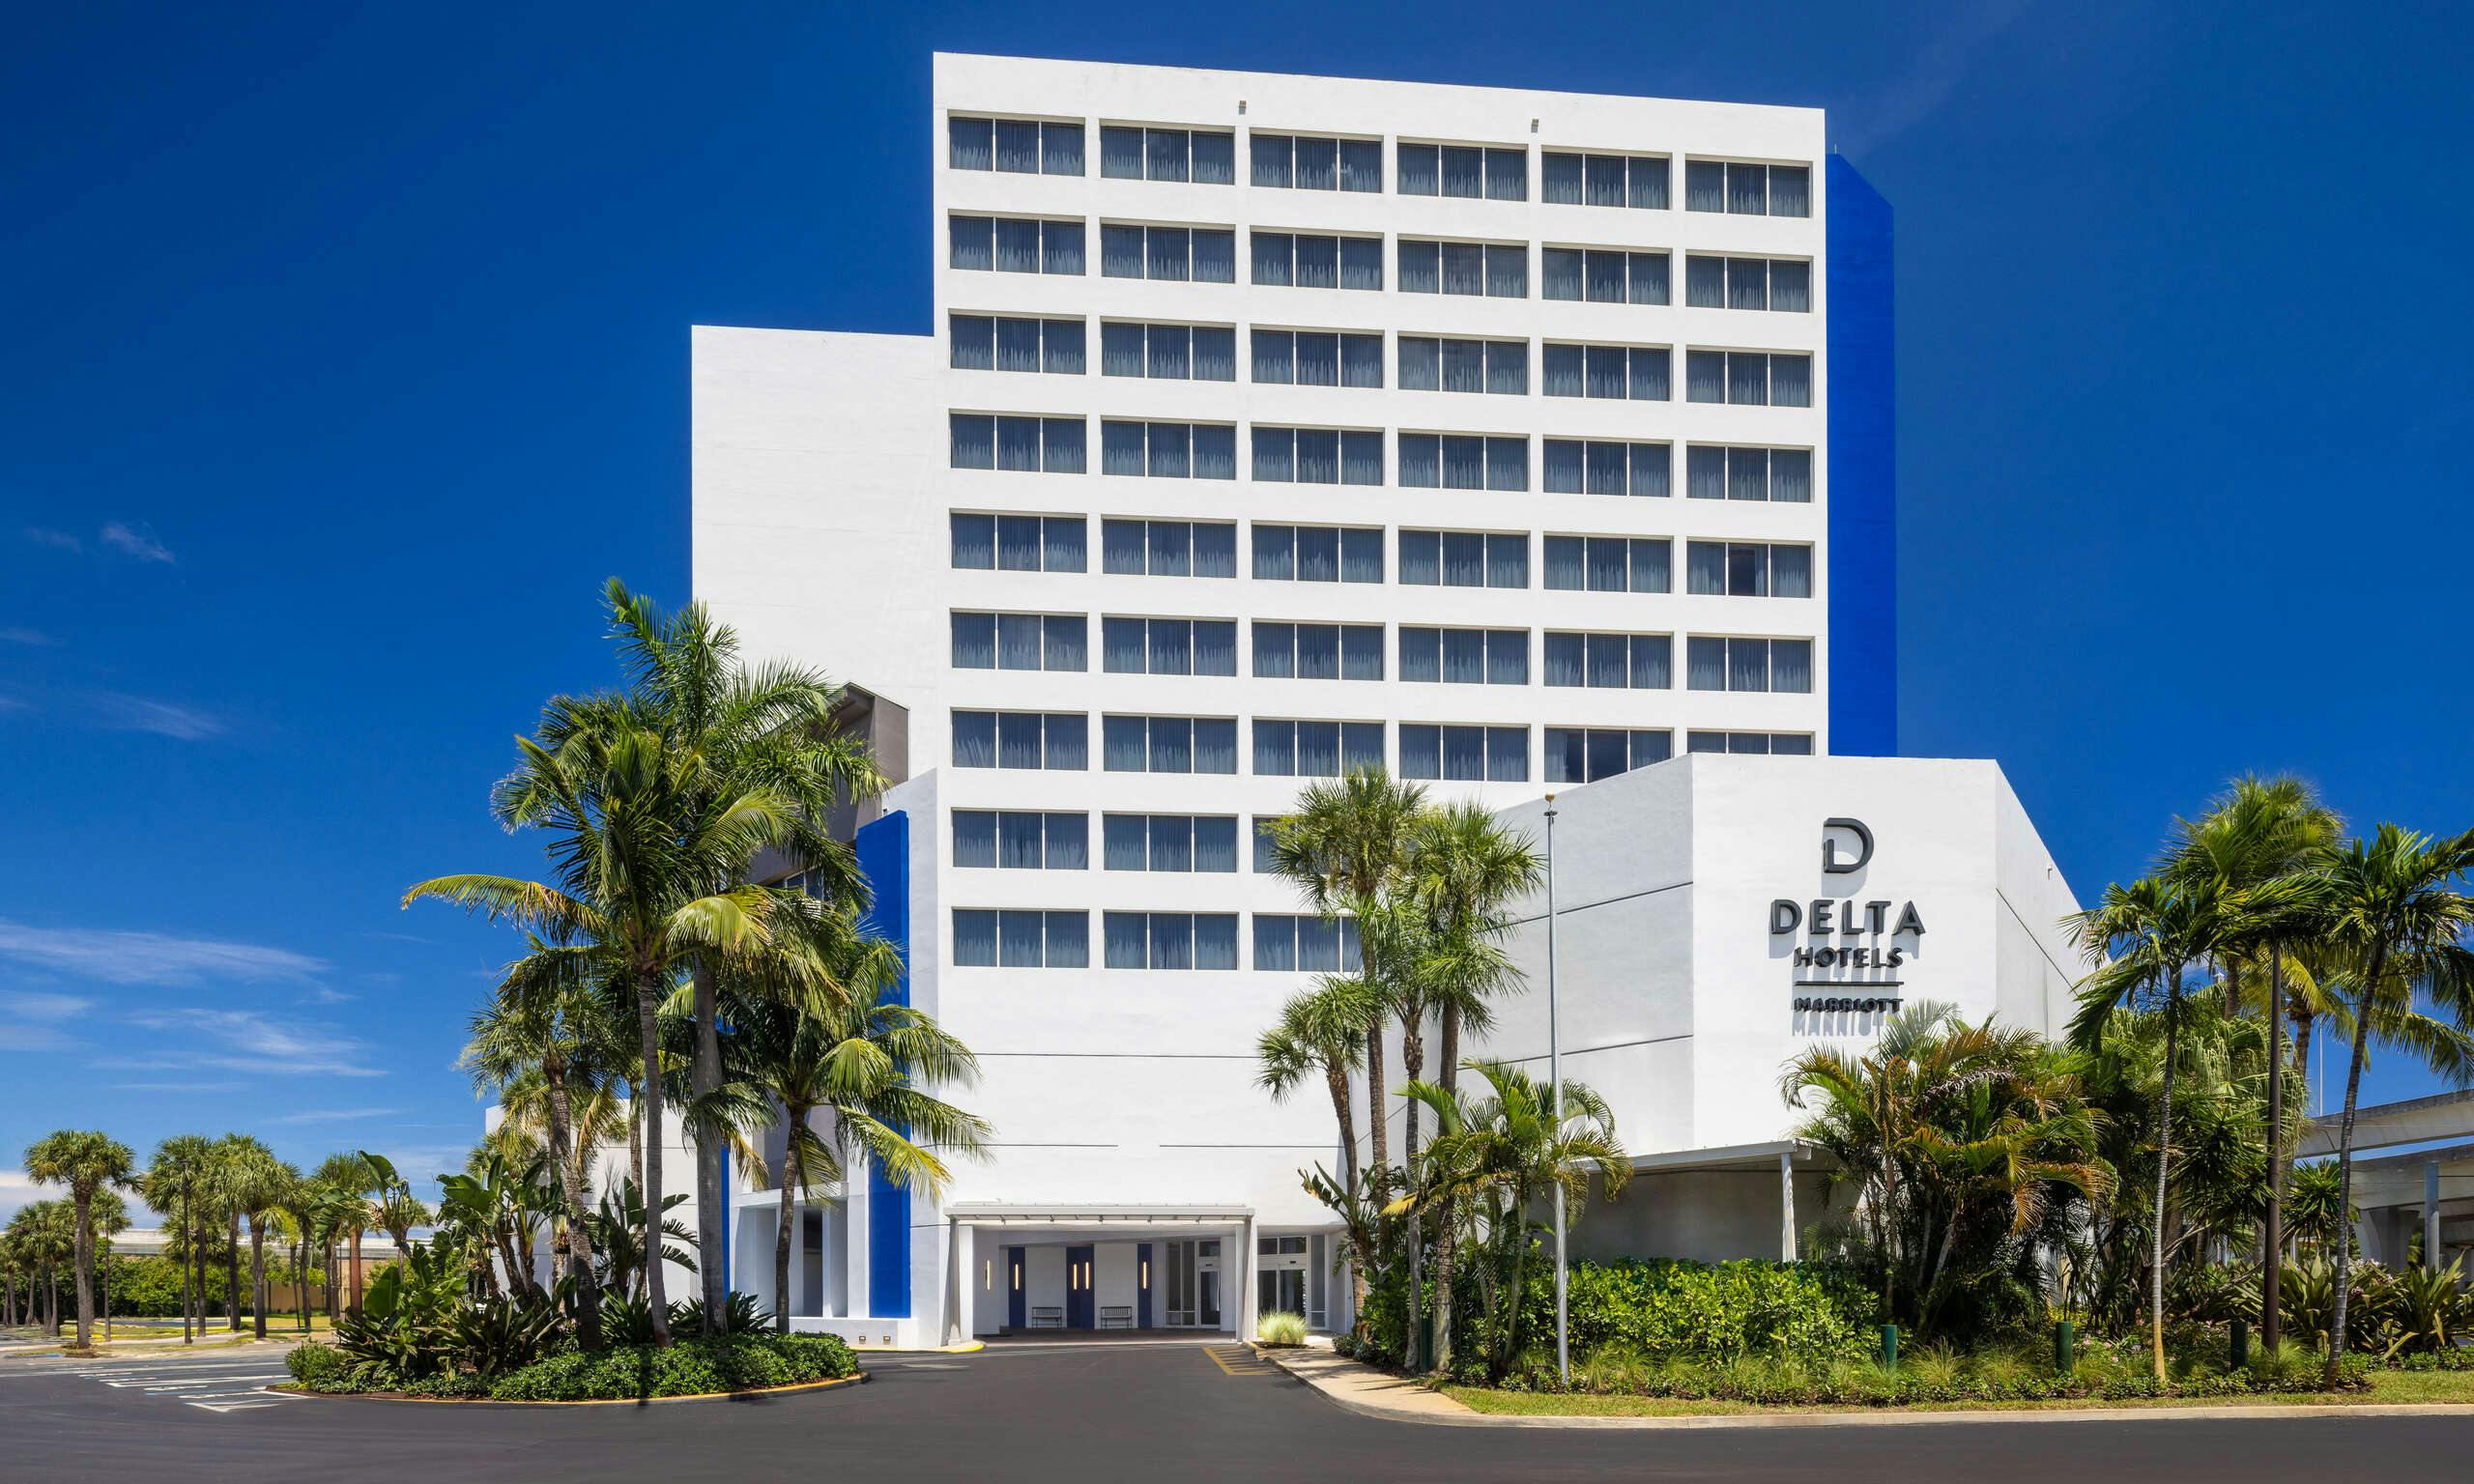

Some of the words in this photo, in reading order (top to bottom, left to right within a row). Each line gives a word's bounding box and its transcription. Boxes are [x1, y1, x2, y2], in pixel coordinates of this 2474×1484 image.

[1770, 899, 1926, 935] DELTA
[1794, 947, 1904, 968] HOTELS
[1794, 997, 1904, 1013] MARRIOTT
